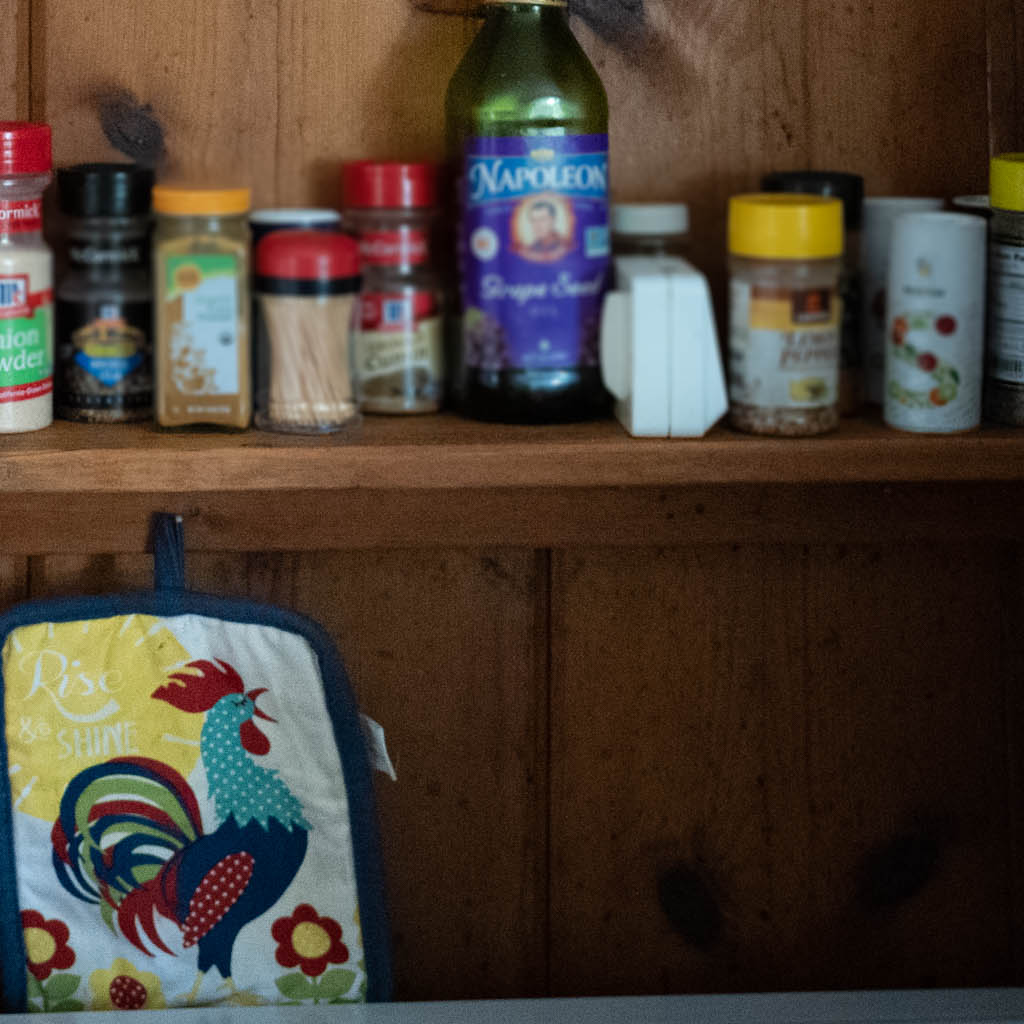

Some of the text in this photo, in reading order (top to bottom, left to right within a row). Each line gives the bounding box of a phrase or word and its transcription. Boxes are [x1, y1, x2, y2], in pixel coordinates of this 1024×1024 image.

[469, 158, 607, 201] NAPOLEON
[18, 648, 126, 724] Rise
[56, 720, 139, 760] SHINE
